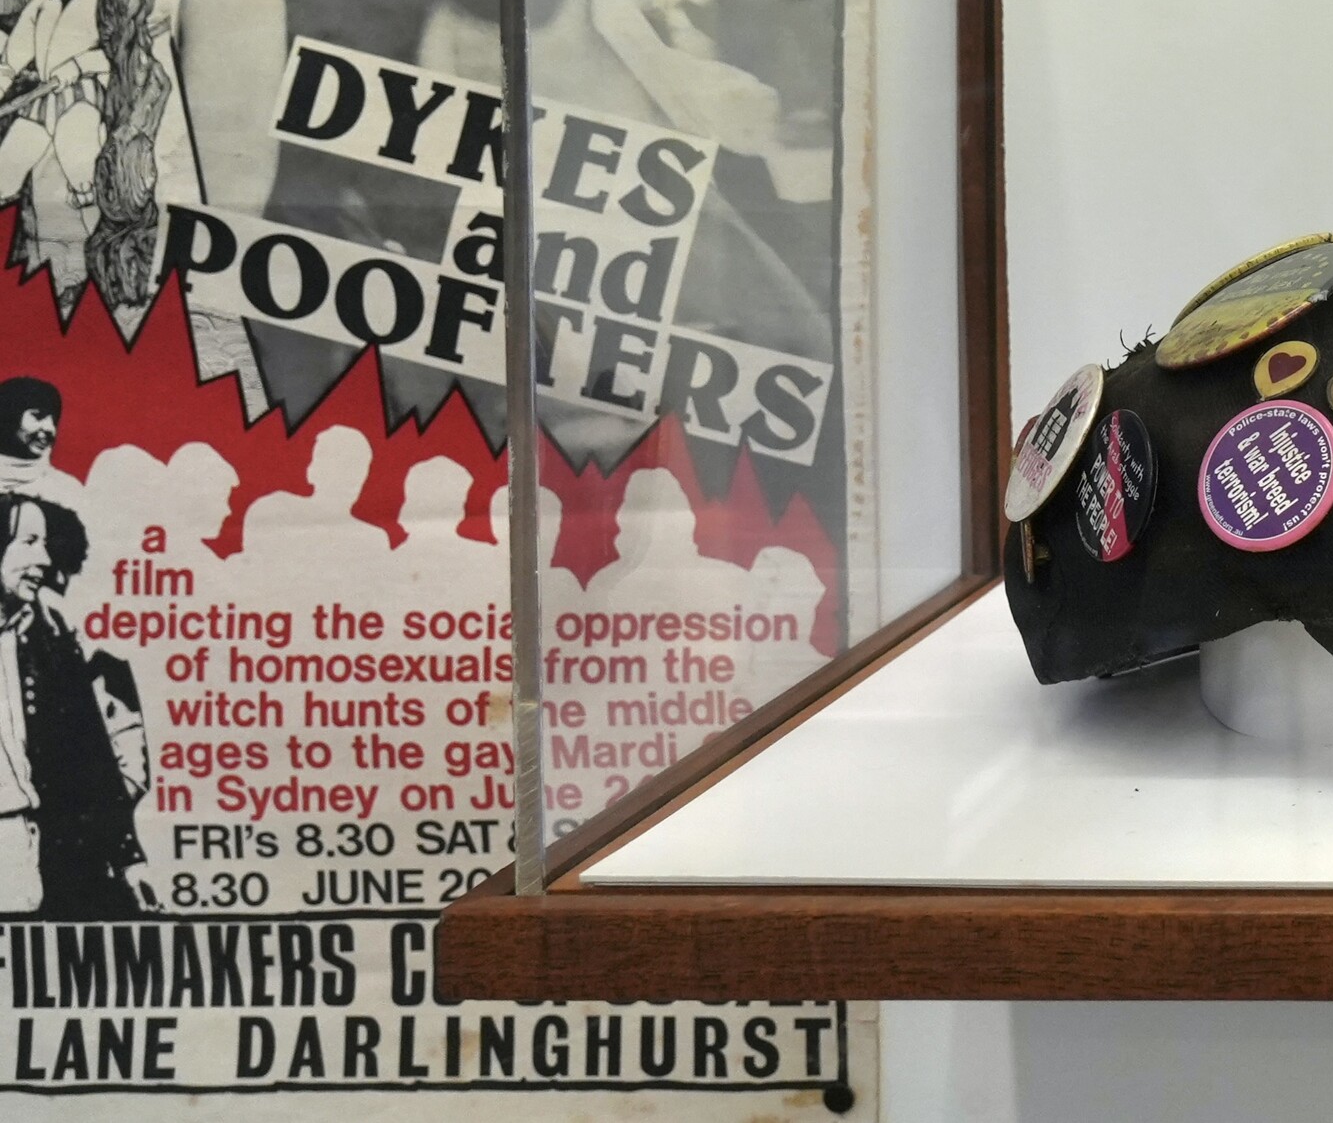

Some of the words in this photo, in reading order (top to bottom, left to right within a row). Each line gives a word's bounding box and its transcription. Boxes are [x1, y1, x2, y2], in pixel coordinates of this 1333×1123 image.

[275, 46, 707, 228] DYKES
[451, 208, 682, 324] and
[160, 204, 824, 452] POOFTERS
[1229, 408, 1297, 437] Police-state
[1237, 431, 1260, 452] &
[1298, 414, 1320, 436] laws
[1244, 445, 1270, 475] war
[1268, 421, 1312, 485] Injustice
[1090, 453, 1115, 505] POWER
[1110, 491, 1124, 520] TO
[1214, 457, 1269, 531] terrorism!
[1257, 466, 1299, 516] breed
[1300, 471, 1328, 517] protect
[1076, 471, 1093, 509] THE
[1086, 492, 1118, 556] PEOPLE!
[1283, 515, 1300, 532] us!
[142, 524, 167, 553] a
[112, 559, 194, 596] film
[84, 603, 292, 647] depicting
[313, 603, 384, 640] the
[402, 603, 513, 640] socia
[555, 604, 798, 647] oppression
[165, 647, 208, 682] of
[229, 646, 513, 683] homosexuals
[544, 647, 646, 684] from
[663, 647, 735, 683] the
[167, 690, 284, 727] witch
[304, 690, 425, 727] hunts
[446, 690, 490, 727] of
[607, 691, 753, 726] middle
[160, 741, 268, 776] ages
[287, 736, 333, 770] to
[353, 733, 425, 770] the
[445, 740, 516, 777] gay
[552, 732, 678, 769] Mardi
[156, 777, 192, 812] in
[216, 775, 380, 821] Sydney
[400, 781, 454, 812] on
[296, 823, 395, 857] 8.30
[415, 820, 499, 855] SAT
[170, 872, 270, 908] 8.30
[301, 869, 424, 907] JUNE
[15, 1017, 178, 1082] LANE
[236, 1016, 832, 1079] DARLINGHURST
